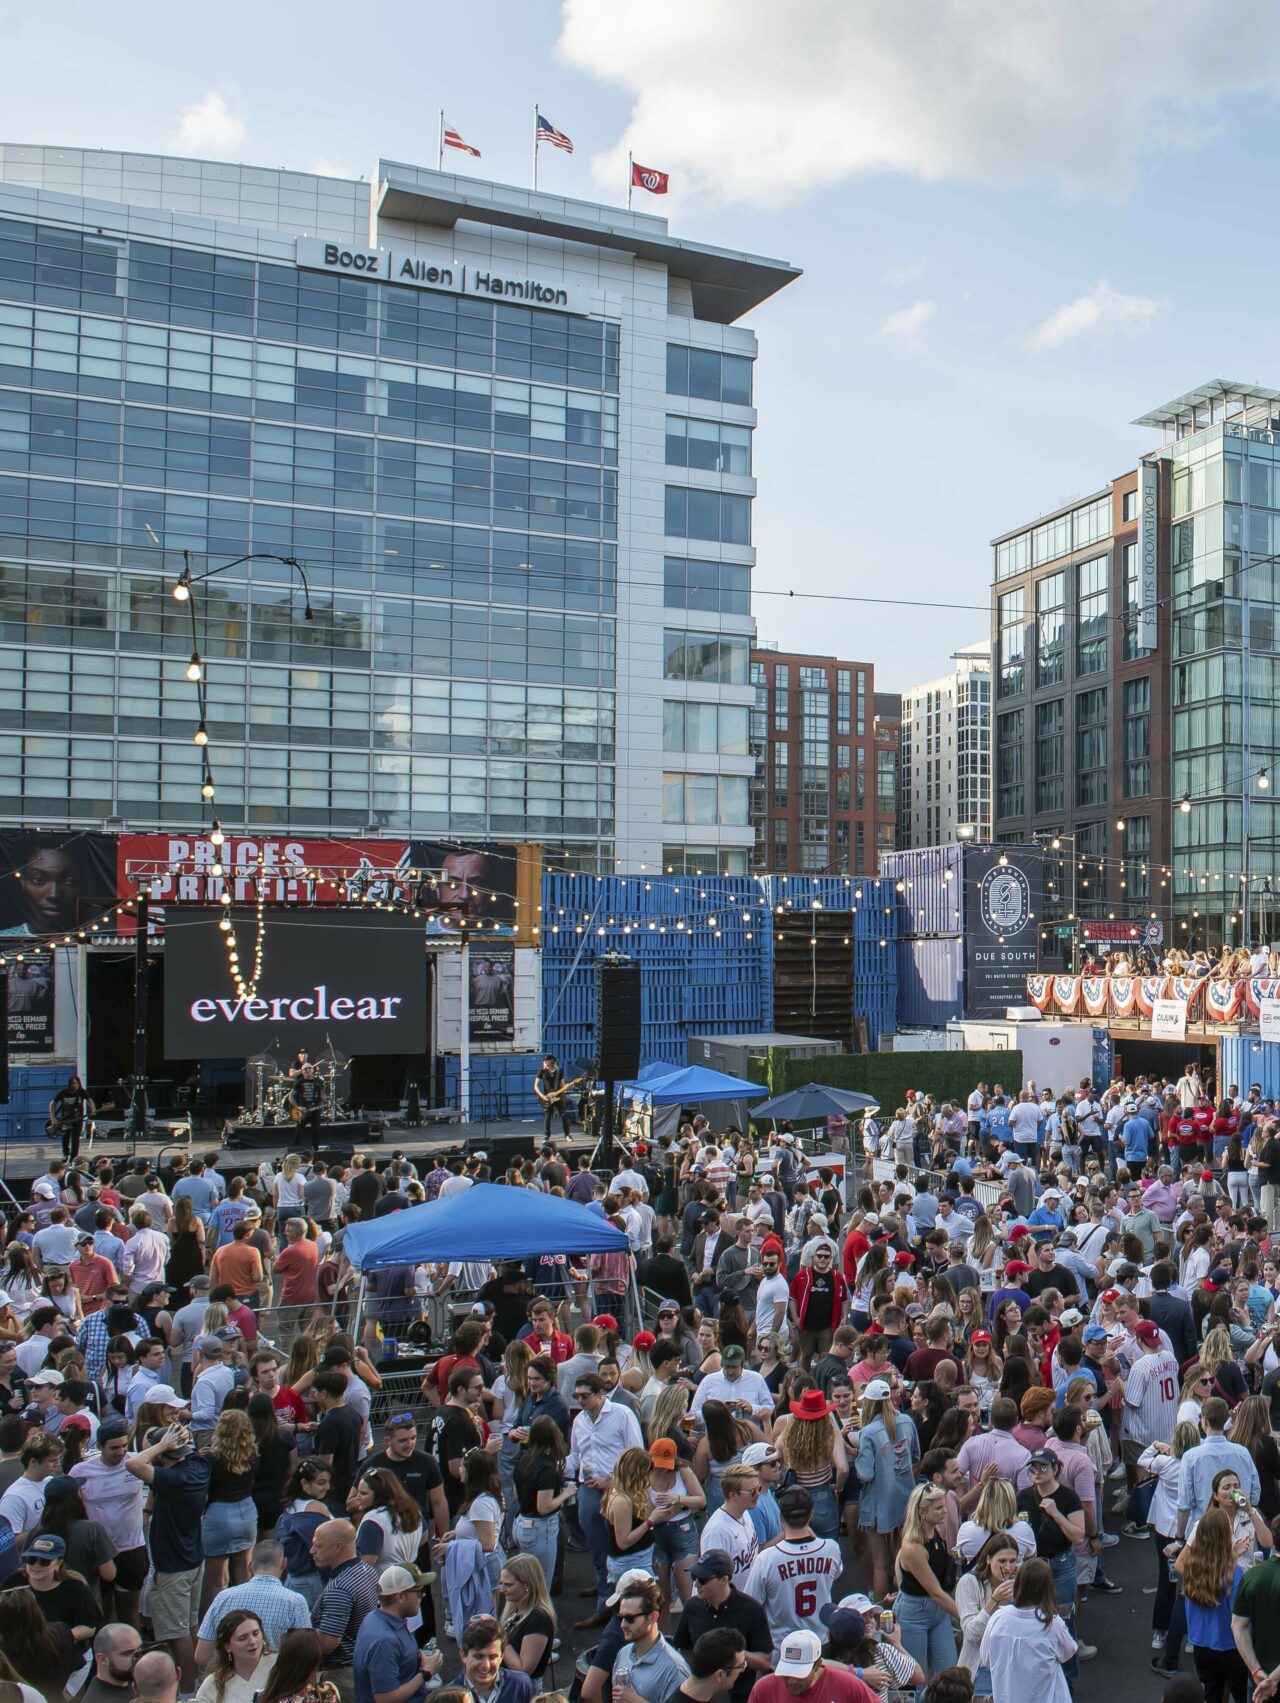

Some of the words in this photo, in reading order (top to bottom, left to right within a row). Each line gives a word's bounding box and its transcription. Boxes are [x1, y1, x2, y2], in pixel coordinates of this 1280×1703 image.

[324, 244, 379, 273] Booz
[400, 257, 454, 285] Allen
[475, 270, 568, 306] Hamilton
[1144, 485, 1155, 575] HOMEWOOD
[168, 840, 306, 876] PRICES
[975, 952, 996, 961] DUE
[1000, 952, 1036, 961] SOUTH
[190, 985, 402, 1022] everclear
[992, 1116, 1005, 1127] 24
[1159, 1377, 1175, 1403] 10
[778, 1557, 833, 1581] RENDON
[794, 1580, 818, 1617] 6
